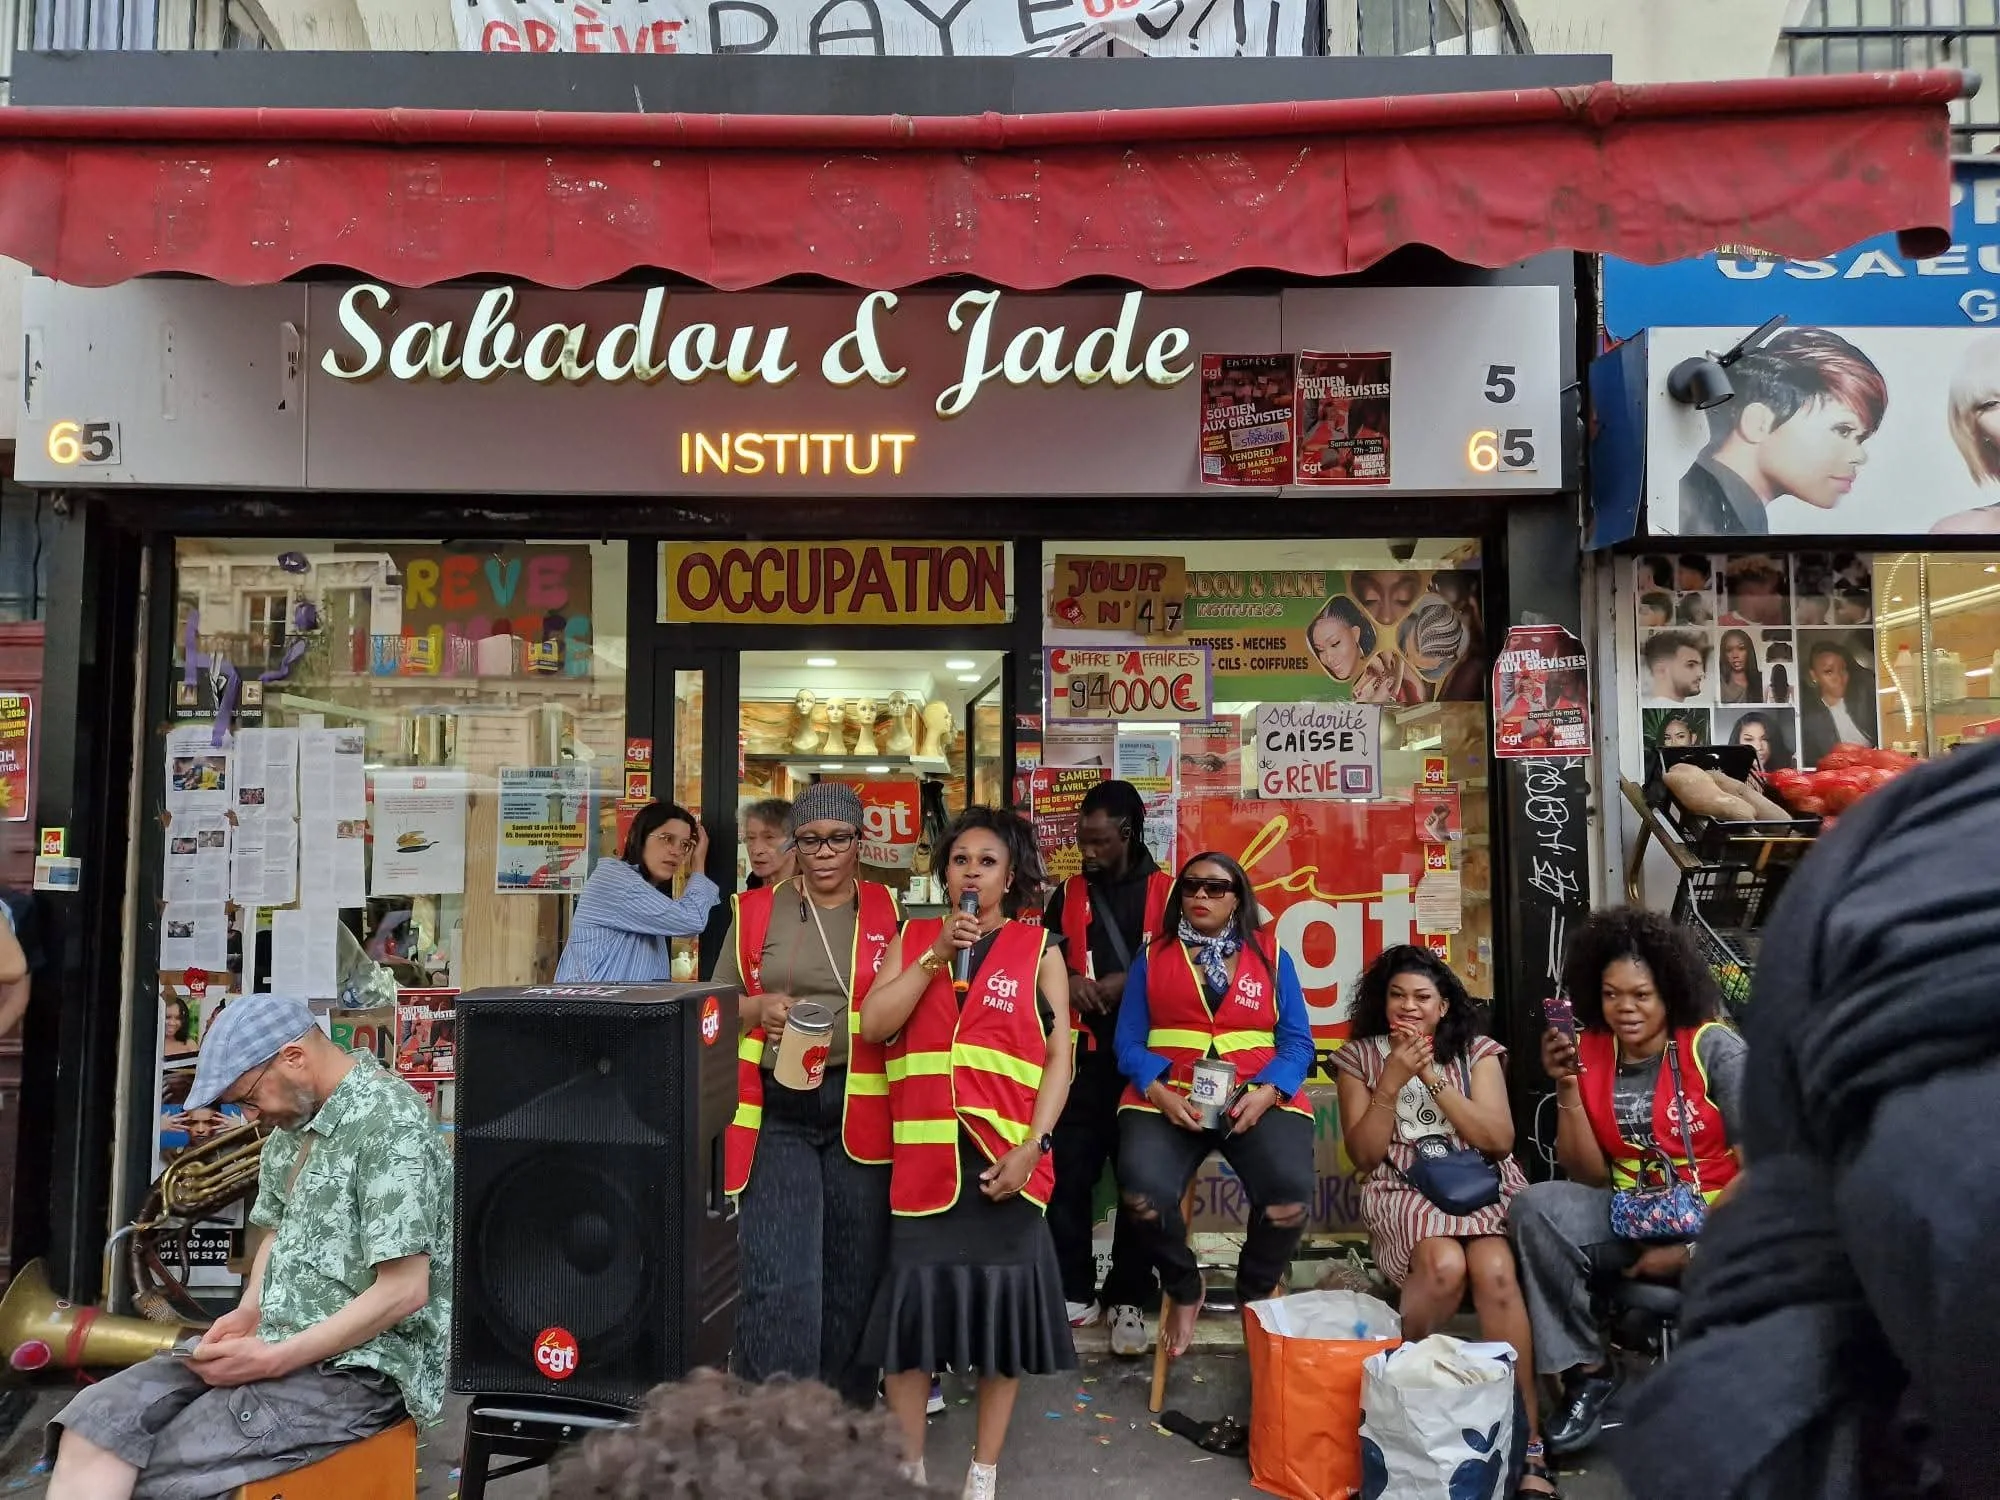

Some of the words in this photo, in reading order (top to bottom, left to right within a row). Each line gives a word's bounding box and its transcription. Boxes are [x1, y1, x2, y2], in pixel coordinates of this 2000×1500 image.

[320, 283, 798, 385] Sabadou
[821, 290, 908, 387] &
[935, 289, 1196, 418] Jade
[1202, 367, 1222, 380] cgt
[1298, 376, 1345, 390] SOUTIEN
[1484, 365, 1516, 404] 5
[1303, 388, 1326, 400] AUX
[1331, 383, 1390, 398] GRÉVISTES
[1207, 403, 1256, 420] SOUTIEN
[1203, 420, 1226, 432] AUX
[47, 421, 114, 464] 65
[680, 431, 917, 475] INSTITUT
[1230, 448, 1274, 462] VENDREDI
[1468, 428, 1535, 472] 65
[1248, 459, 1269, 469] MARS
[1303, 460, 1322, 474] cgt
[676, 546, 1005, 614] OCCUPATION
[1068, 560, 1167, 597] JOUR
[1269, 571, 1327, 598] JANE
[1243, 637, 1287, 650] MECHES
[1218, 657, 1241, 670] CILS
[1250, 657, 1309, 670] COIFFURES
[1498, 661, 1523, 673] AUX
[1525, 655, 1587, 671] GRÉVISTES
[1266, 730, 1354, 752] CAISSE
[1502, 733, 1522, 745] cgt
[627, 746, 650, 761] cgt
[1258, 756, 1277, 769] de
[1059, 768, 1101, 782] SAMEDI
[1264, 759, 1338, 794] GRÈVE
[1426, 771, 1444, 781] cgt
[629, 785, 648, 797] cgt
[1034, 778, 1048, 790] cgt
[1062, 781, 1086, 792] AVRIL
[1428, 857, 1447, 867] cgt
[1430, 945, 1448, 957] cgt
[190, 981, 205, 991] cgt
[987, 974, 1018, 998] cgt
[1238, 979, 1263, 998] cgt
[982, 995, 1014, 1014] PARIS
[1234, 994, 1260, 1011] PARIS
[398, 1005, 430, 1015] SOUTIEN
[702, 1011, 719, 1038] cgt
[400, 1062, 413, 1070] cgt
[1670, 1120, 1705, 1137] PRIS
[187, 1240, 199, 1248] 60
[202, 1240, 215, 1248] 49
[217, 1240, 230, 1248] 08
[160, 1251, 172, 1260] 07
[189, 1251, 199, 1259] 16
[201, 1251, 213, 1260] 52
[215, 1251, 228, 1260] 72
[537, 1345, 574, 1372] cgt
